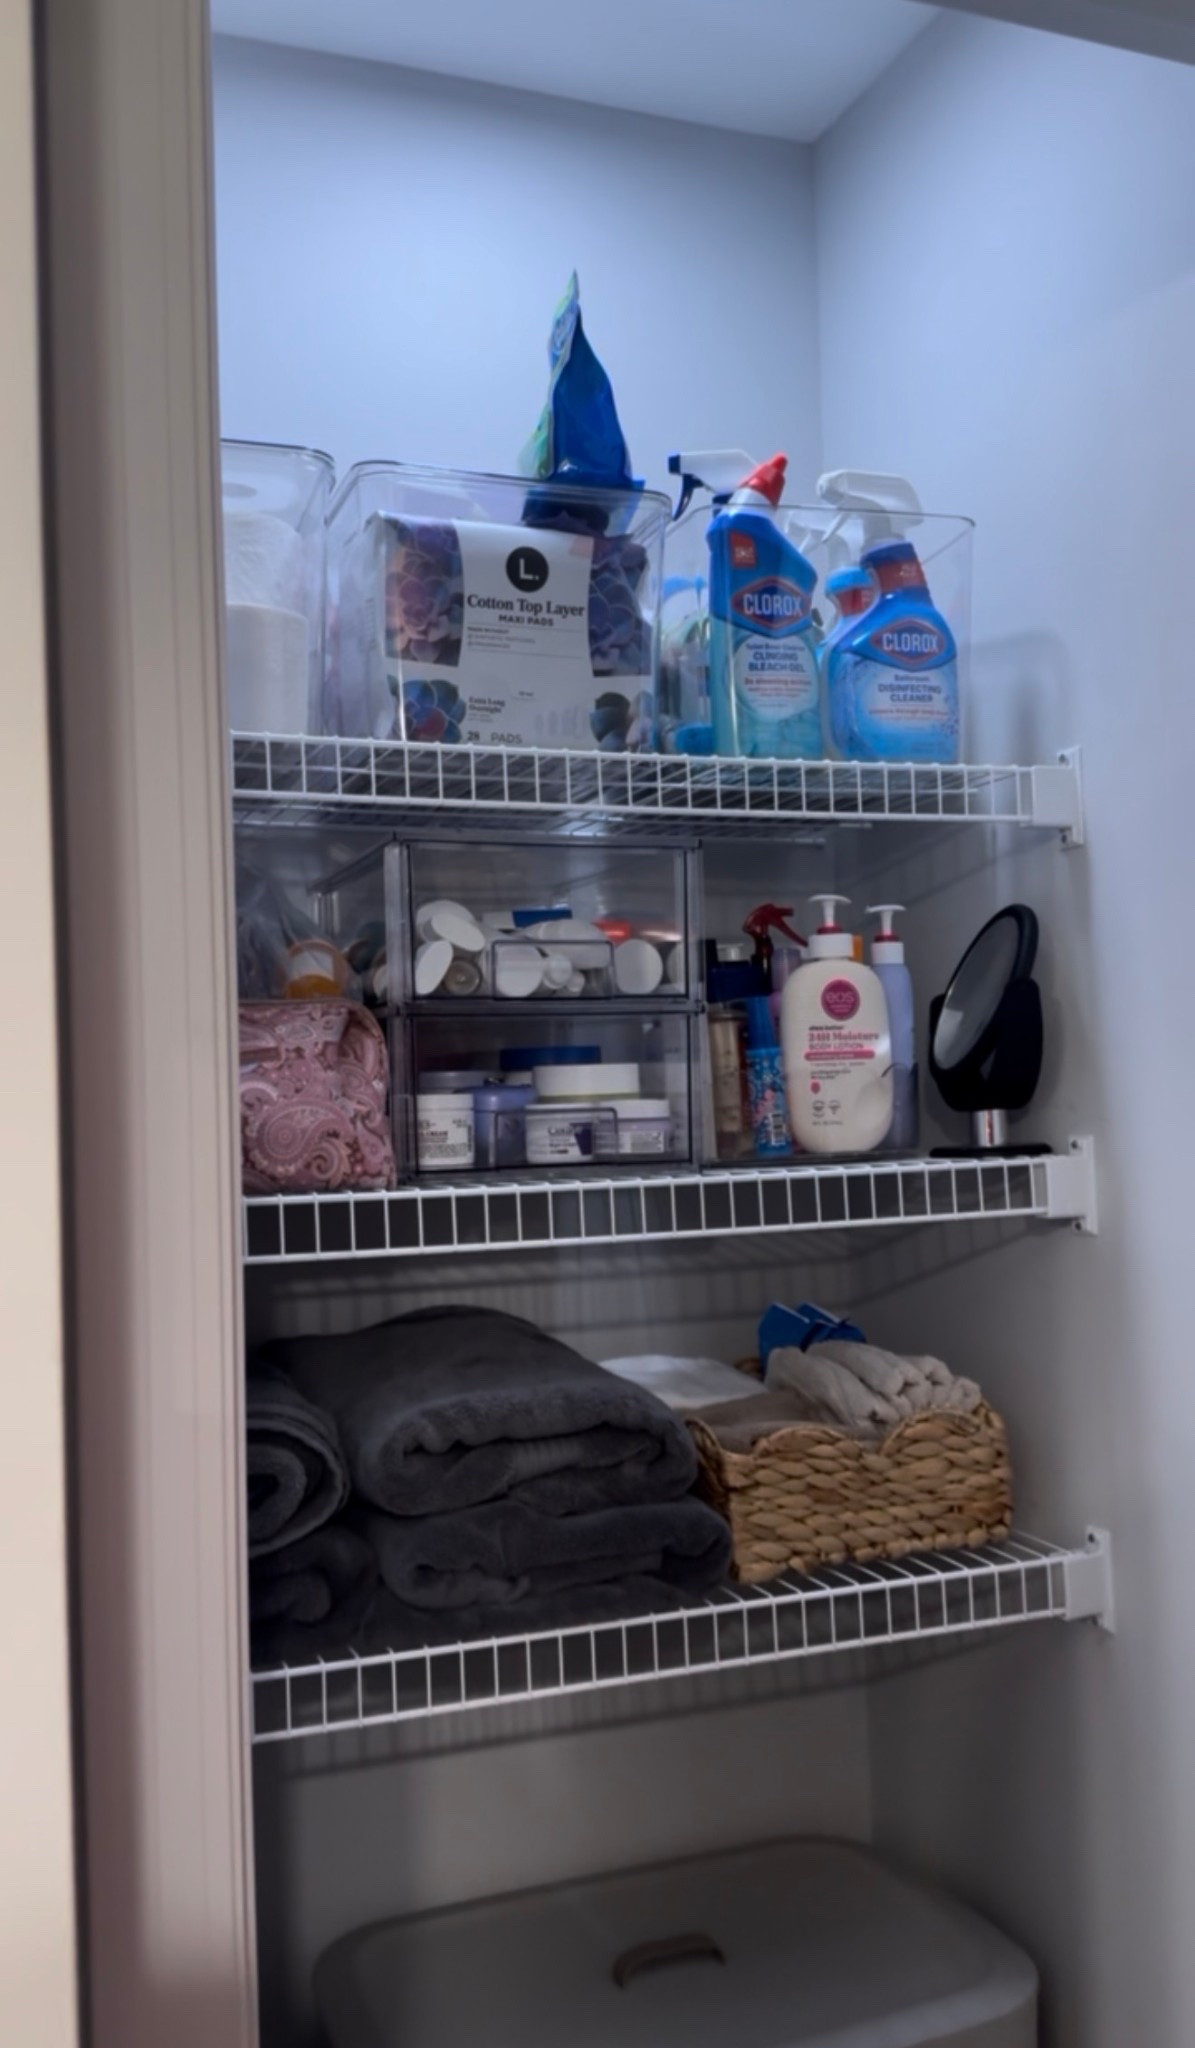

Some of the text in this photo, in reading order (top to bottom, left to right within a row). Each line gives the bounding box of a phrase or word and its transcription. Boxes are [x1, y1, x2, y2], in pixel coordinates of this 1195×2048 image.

[467, 594, 585, 619] Cotton Top Layer
[742, 593, 803, 617] CLOROX
[498, 614, 555, 627] MAXI PADS
[882, 632, 939, 654] CLOROX
[748, 662, 789, 673] BLEACH
[878, 683, 942, 695] DISINFECTING
[890, 693, 933, 703] CLEANER
[491, 732, 523, 745] PADS
[832, 1030, 879, 1041] Moisture
